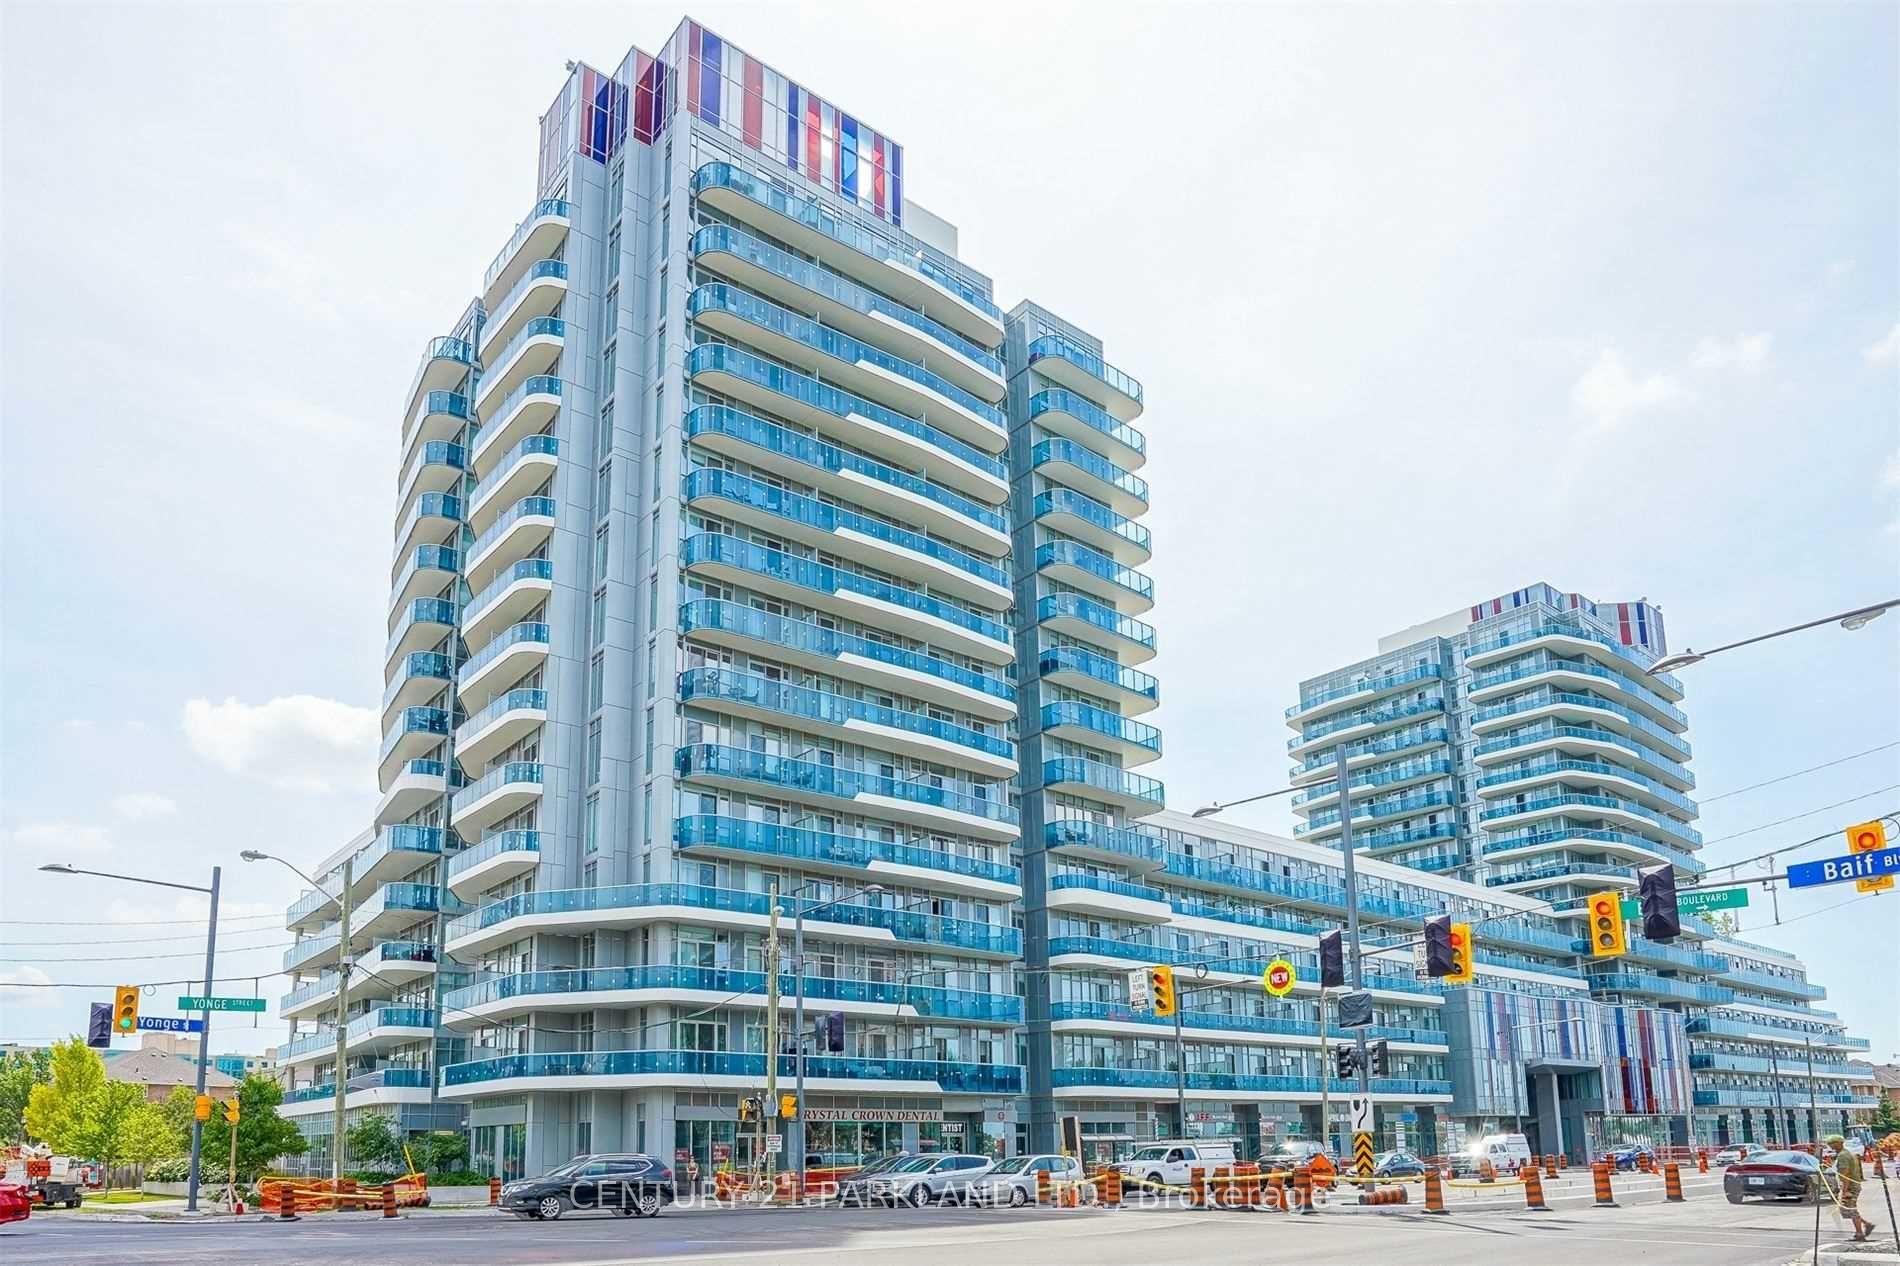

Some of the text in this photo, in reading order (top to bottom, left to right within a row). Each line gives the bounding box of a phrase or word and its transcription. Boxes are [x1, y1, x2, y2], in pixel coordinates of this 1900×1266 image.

[1823, 853, 1900, 881] Baif Bl
[1676, 893, 1728, 906] BOULEVARD
[1271, 971, 1288, 985] NEW
[192, 998, 228, 1010] YONGE
[138, 1016, 179, 1031] Yonge
[804, 1109, 939, 1121] RYSTAL CROWN DENTAL
[941, 1123, 963, 1133] NTIST
